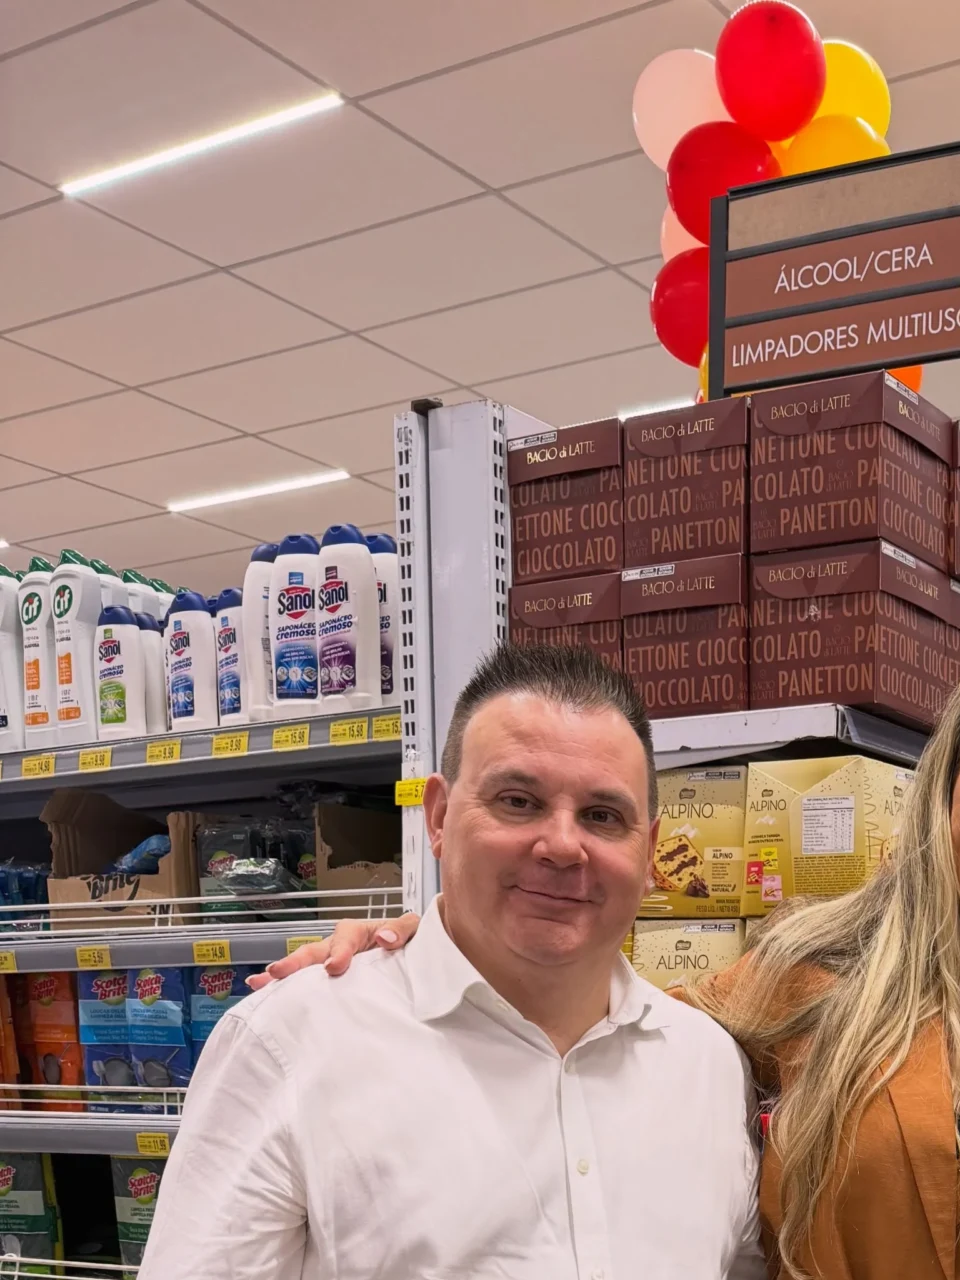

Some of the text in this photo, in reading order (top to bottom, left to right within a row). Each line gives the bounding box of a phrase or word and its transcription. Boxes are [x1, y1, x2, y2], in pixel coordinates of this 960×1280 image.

[774, 243, 933, 294] ÁLCOOL/CERA
[732, 324, 859, 368] LIMPADORES
[771, 394, 851, 420] BACIO di LATTE
[898, 400, 921, 424] BACIO
[641, 417, 715, 442] BACIO di LATTE
[526, 447, 557, 465] BACIO
[559, 445, 567, 458] di
[568, 440, 596, 456] LATTE
[780, 496, 877, 537] PANETTON
[651, 515, 741, 555] PANETTON
[883, 499, 945, 558] CIOCCOLATO
[517, 536, 617, 576] CIOCCOLATO
[769, 567, 805, 583] BACIO
[818, 561, 848, 578] LATTE
[641, 576, 715, 597] BACIO di LATTE
[23, 598, 40, 621] Cif
[55, 589, 71, 615] Cif
[277, 590, 315, 615] Sanol
[318, 588, 348, 611] Sanol
[524, 597, 556, 613] BACIO
[567, 592, 593, 607] LATTE
[218, 628, 236, 652] Sanol
[276, 629, 316, 641] cremoso
[318, 621, 353, 636] cremoso
[99, 640, 121, 661] Sanol
[170, 632, 190, 654] Sanol
[779, 662, 873, 698] PANETTON
[660, 803, 714, 819] ALPINO
[749, 799, 787, 812] ALPINO
[656, 954, 709, 970] ALPINO
[99, 984, 128, 1000] Brite
[138, 984, 162, 1000] Brite
[207, 979, 232, 997] Brite
[128, 1172, 160, 1189] Scotch-
[132, 1182, 155, 1198] Brite
